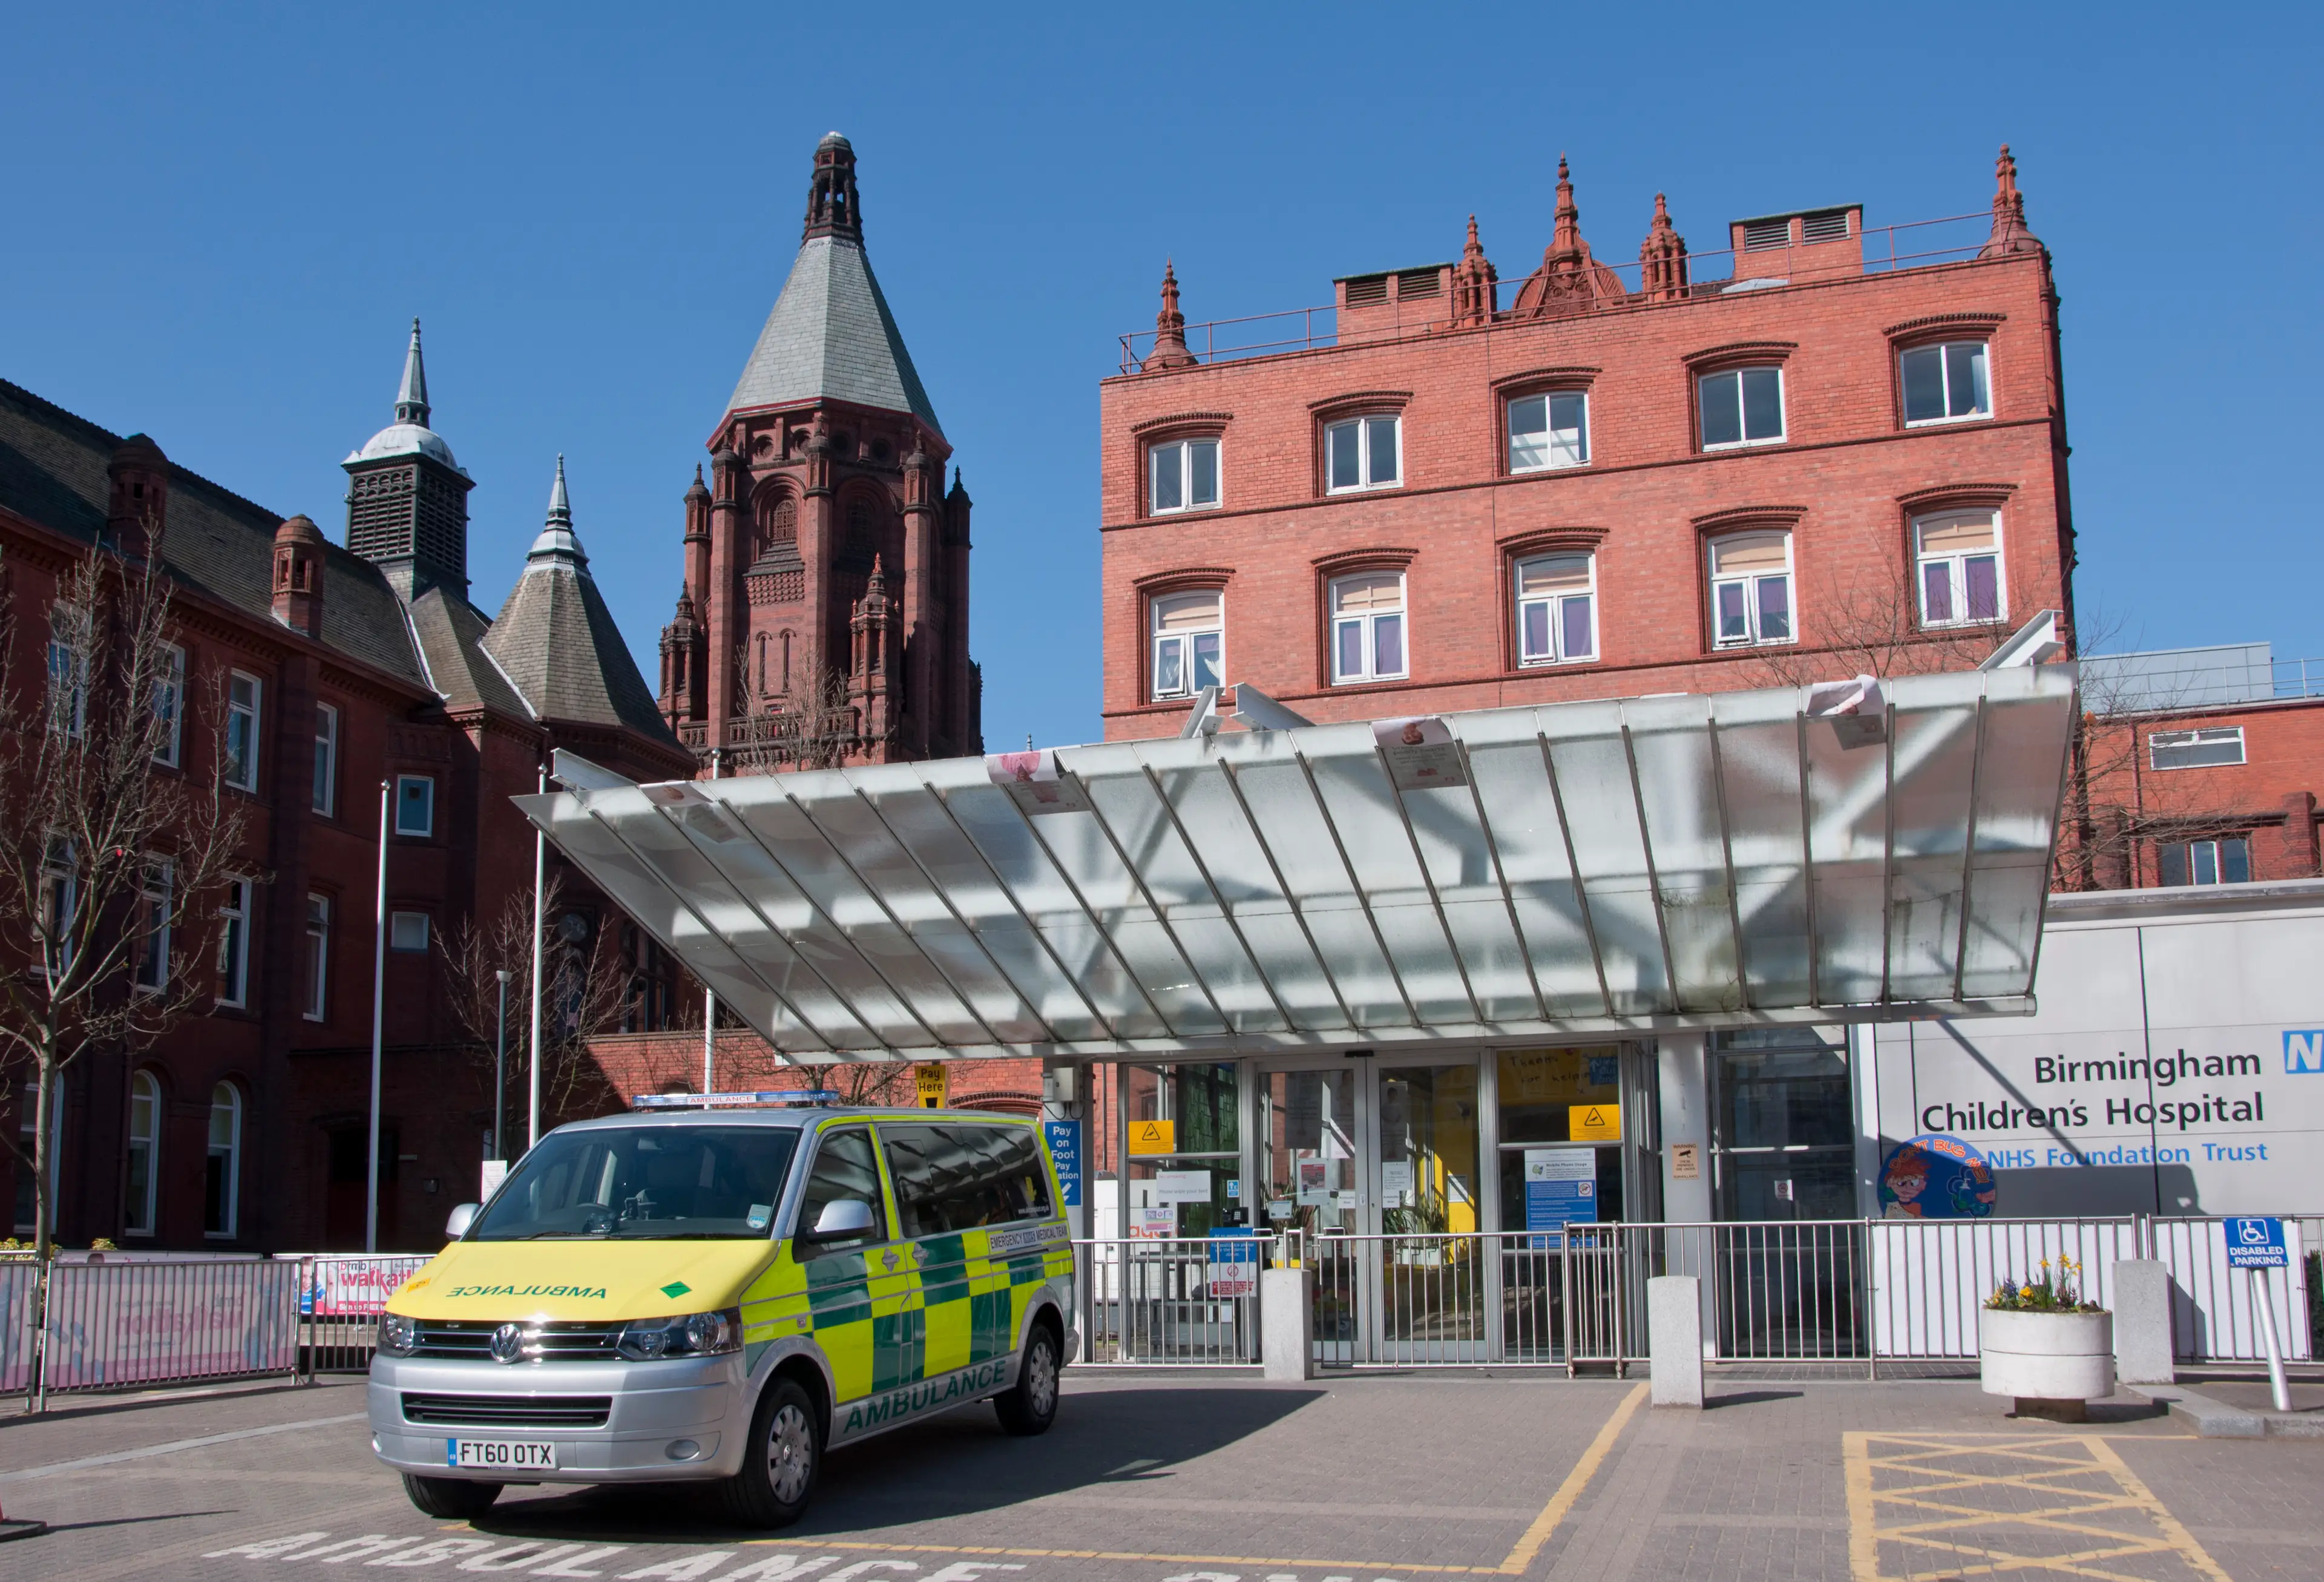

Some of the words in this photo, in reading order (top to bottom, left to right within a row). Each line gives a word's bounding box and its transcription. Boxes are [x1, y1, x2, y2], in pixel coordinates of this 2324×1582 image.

[2035, 1048, 2261, 1086] Birmingham
[921, 1068, 939, 1081] Pay
[1552, 1072, 1590, 1082] helpin
[919, 1082, 943, 1092] Here
[1922, 1100, 2089, 1132] Children's
[2106, 1092, 2263, 1130] Hospital
[1053, 1126, 1071, 1137] Pay
[1051, 1150, 1074, 1159] Foot
[1888, 1140, 1929, 1172] DON'T
[1933, 1139, 1966, 1157] BUG
[1988, 1149, 2035, 1169] NHS
[2047, 1146, 2190, 1167] Foundation
[2202, 1141, 2268, 1161] Trust
[1055, 1162, 1071, 1170] Pay
[990, 1232, 1022, 1249] EMERGENCY
[1036, 1227, 1056, 1240] MEDICAL
[1055, 1225, 1068, 1238] TEAM
[2230, 1247, 2283, 1256] DISABLED
[341, 1262, 367, 1270] brmb
[2234, 1256, 2283, 1265] PARKING
[843, 1360, 1006, 1433] AMBULANCE
[462, 1443, 508, 1463] FT60
